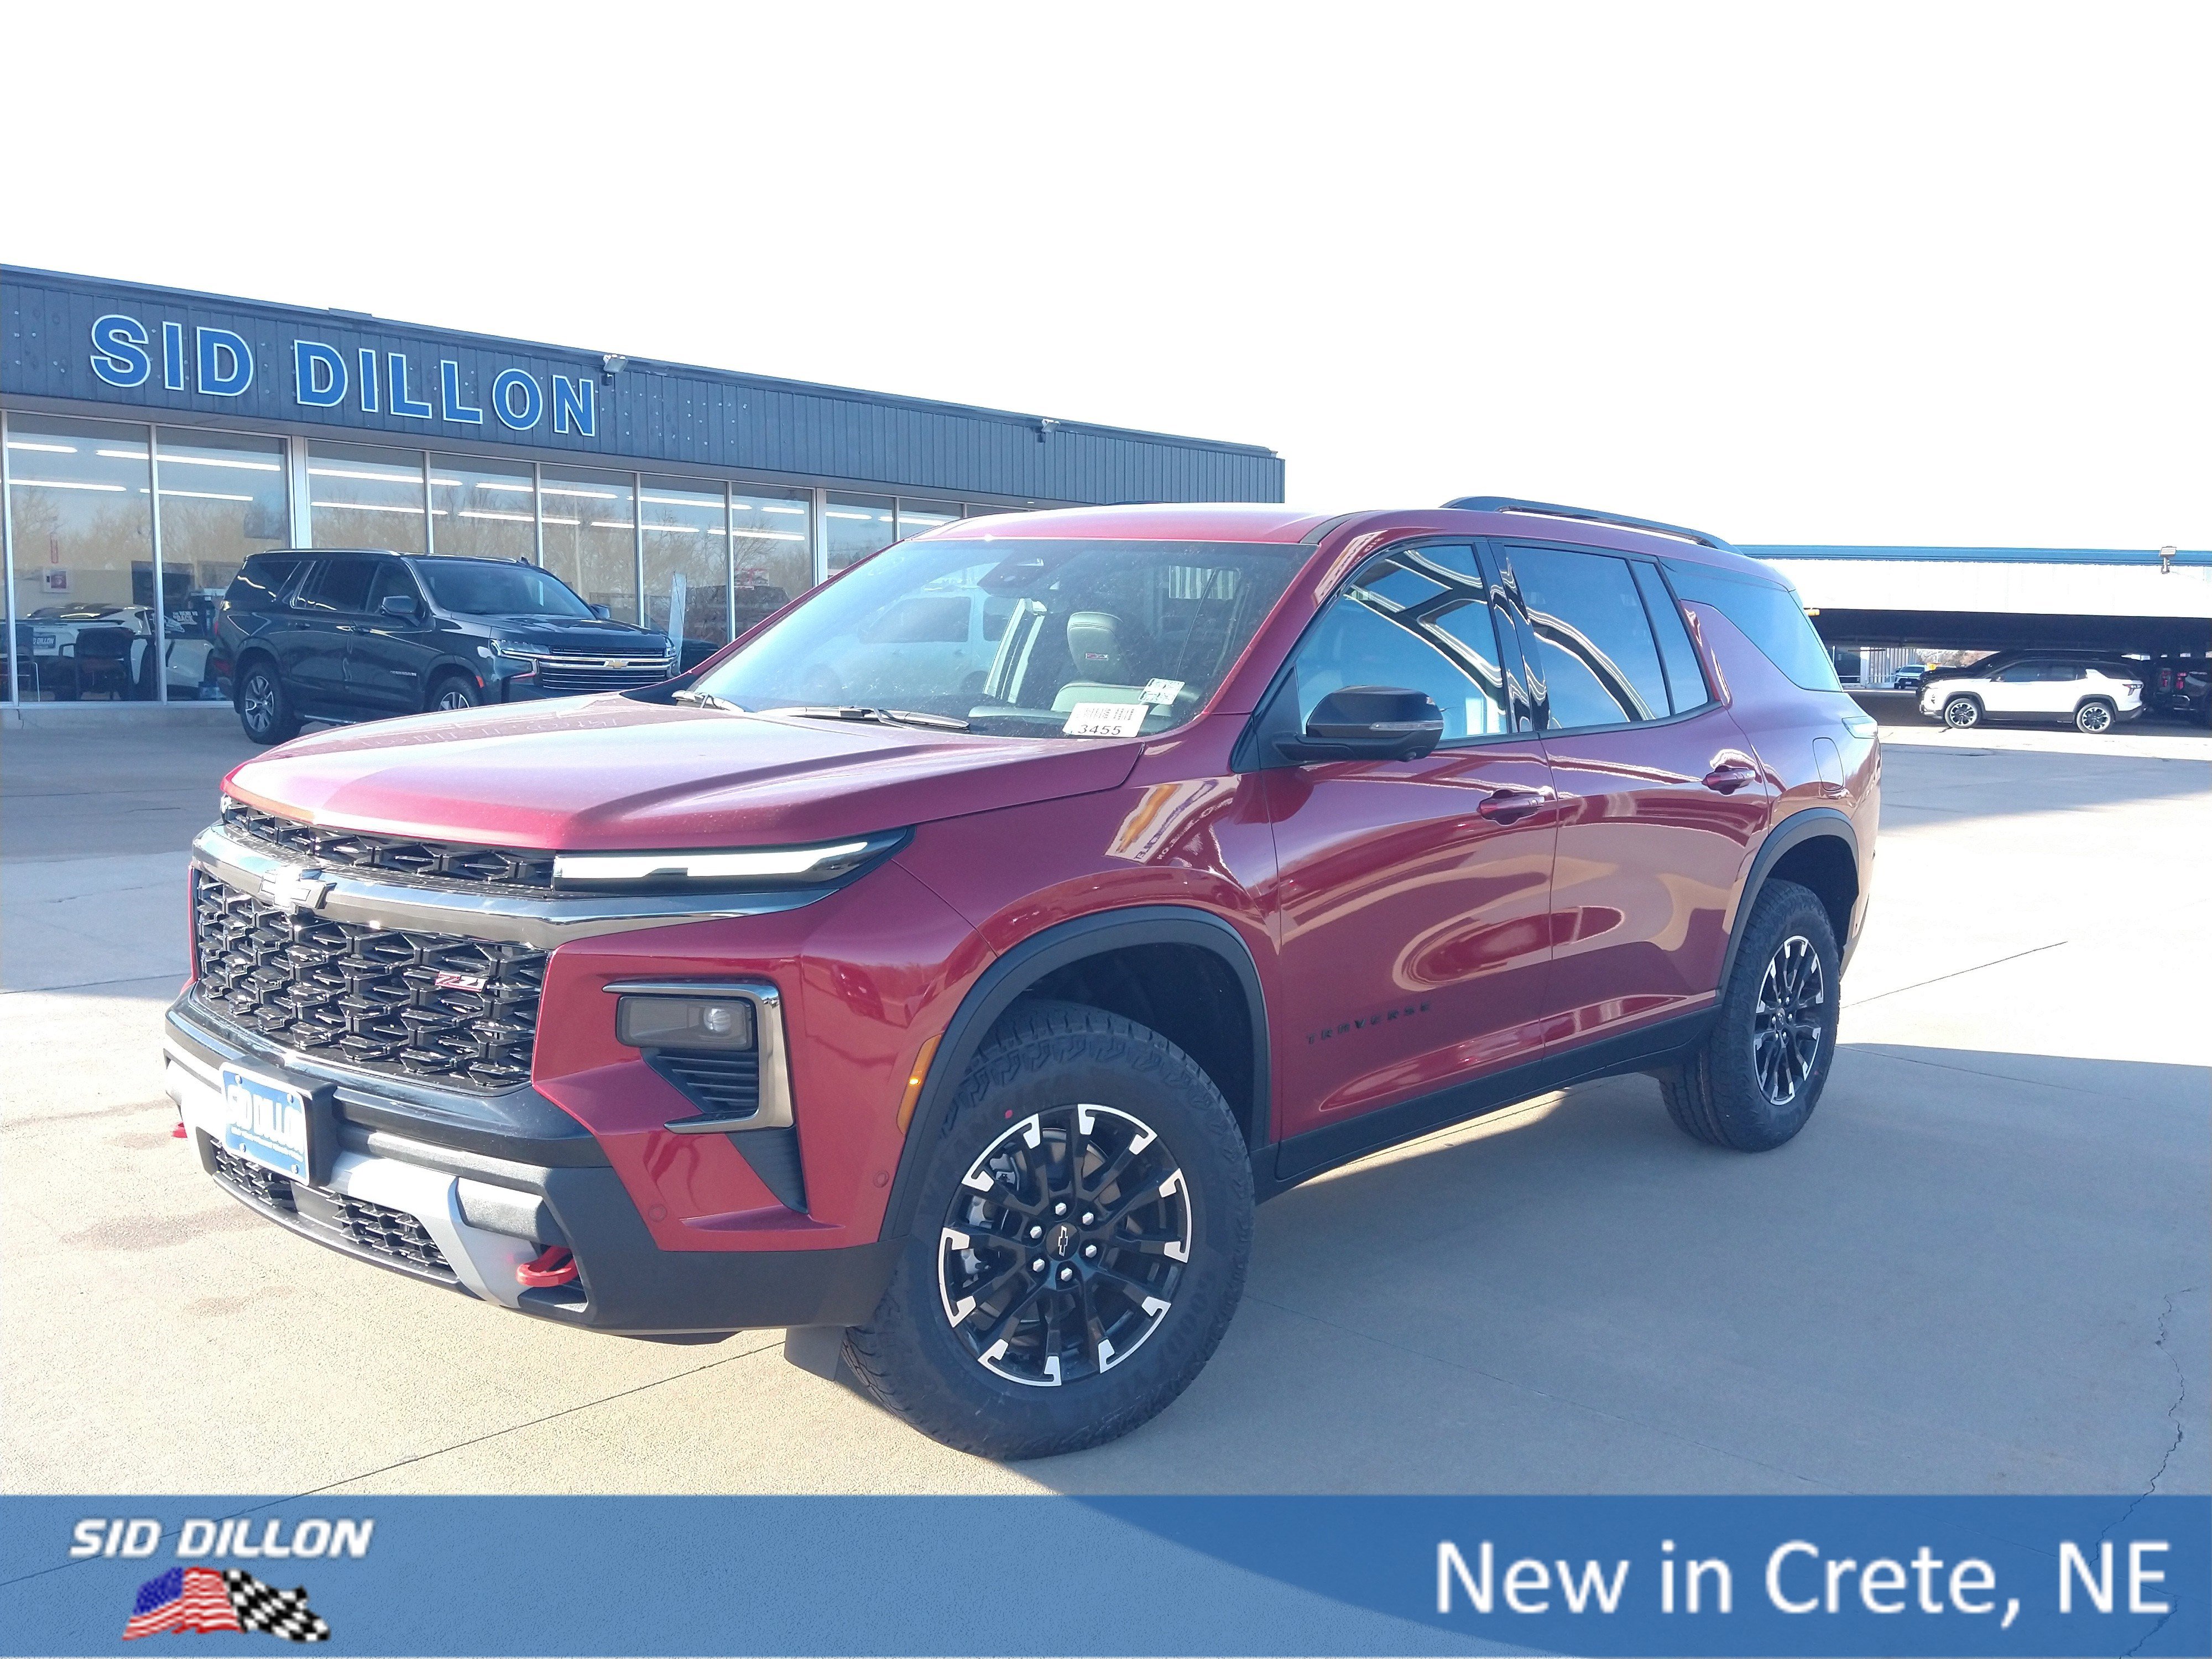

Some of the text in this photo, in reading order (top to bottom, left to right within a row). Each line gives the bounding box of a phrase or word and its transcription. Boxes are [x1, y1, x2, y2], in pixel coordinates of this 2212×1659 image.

[90, 314, 595, 437] SID DILLON
[1077, 724, 1122, 735] 3455
[1307, 1002, 1430, 1045] TRAVERSE
